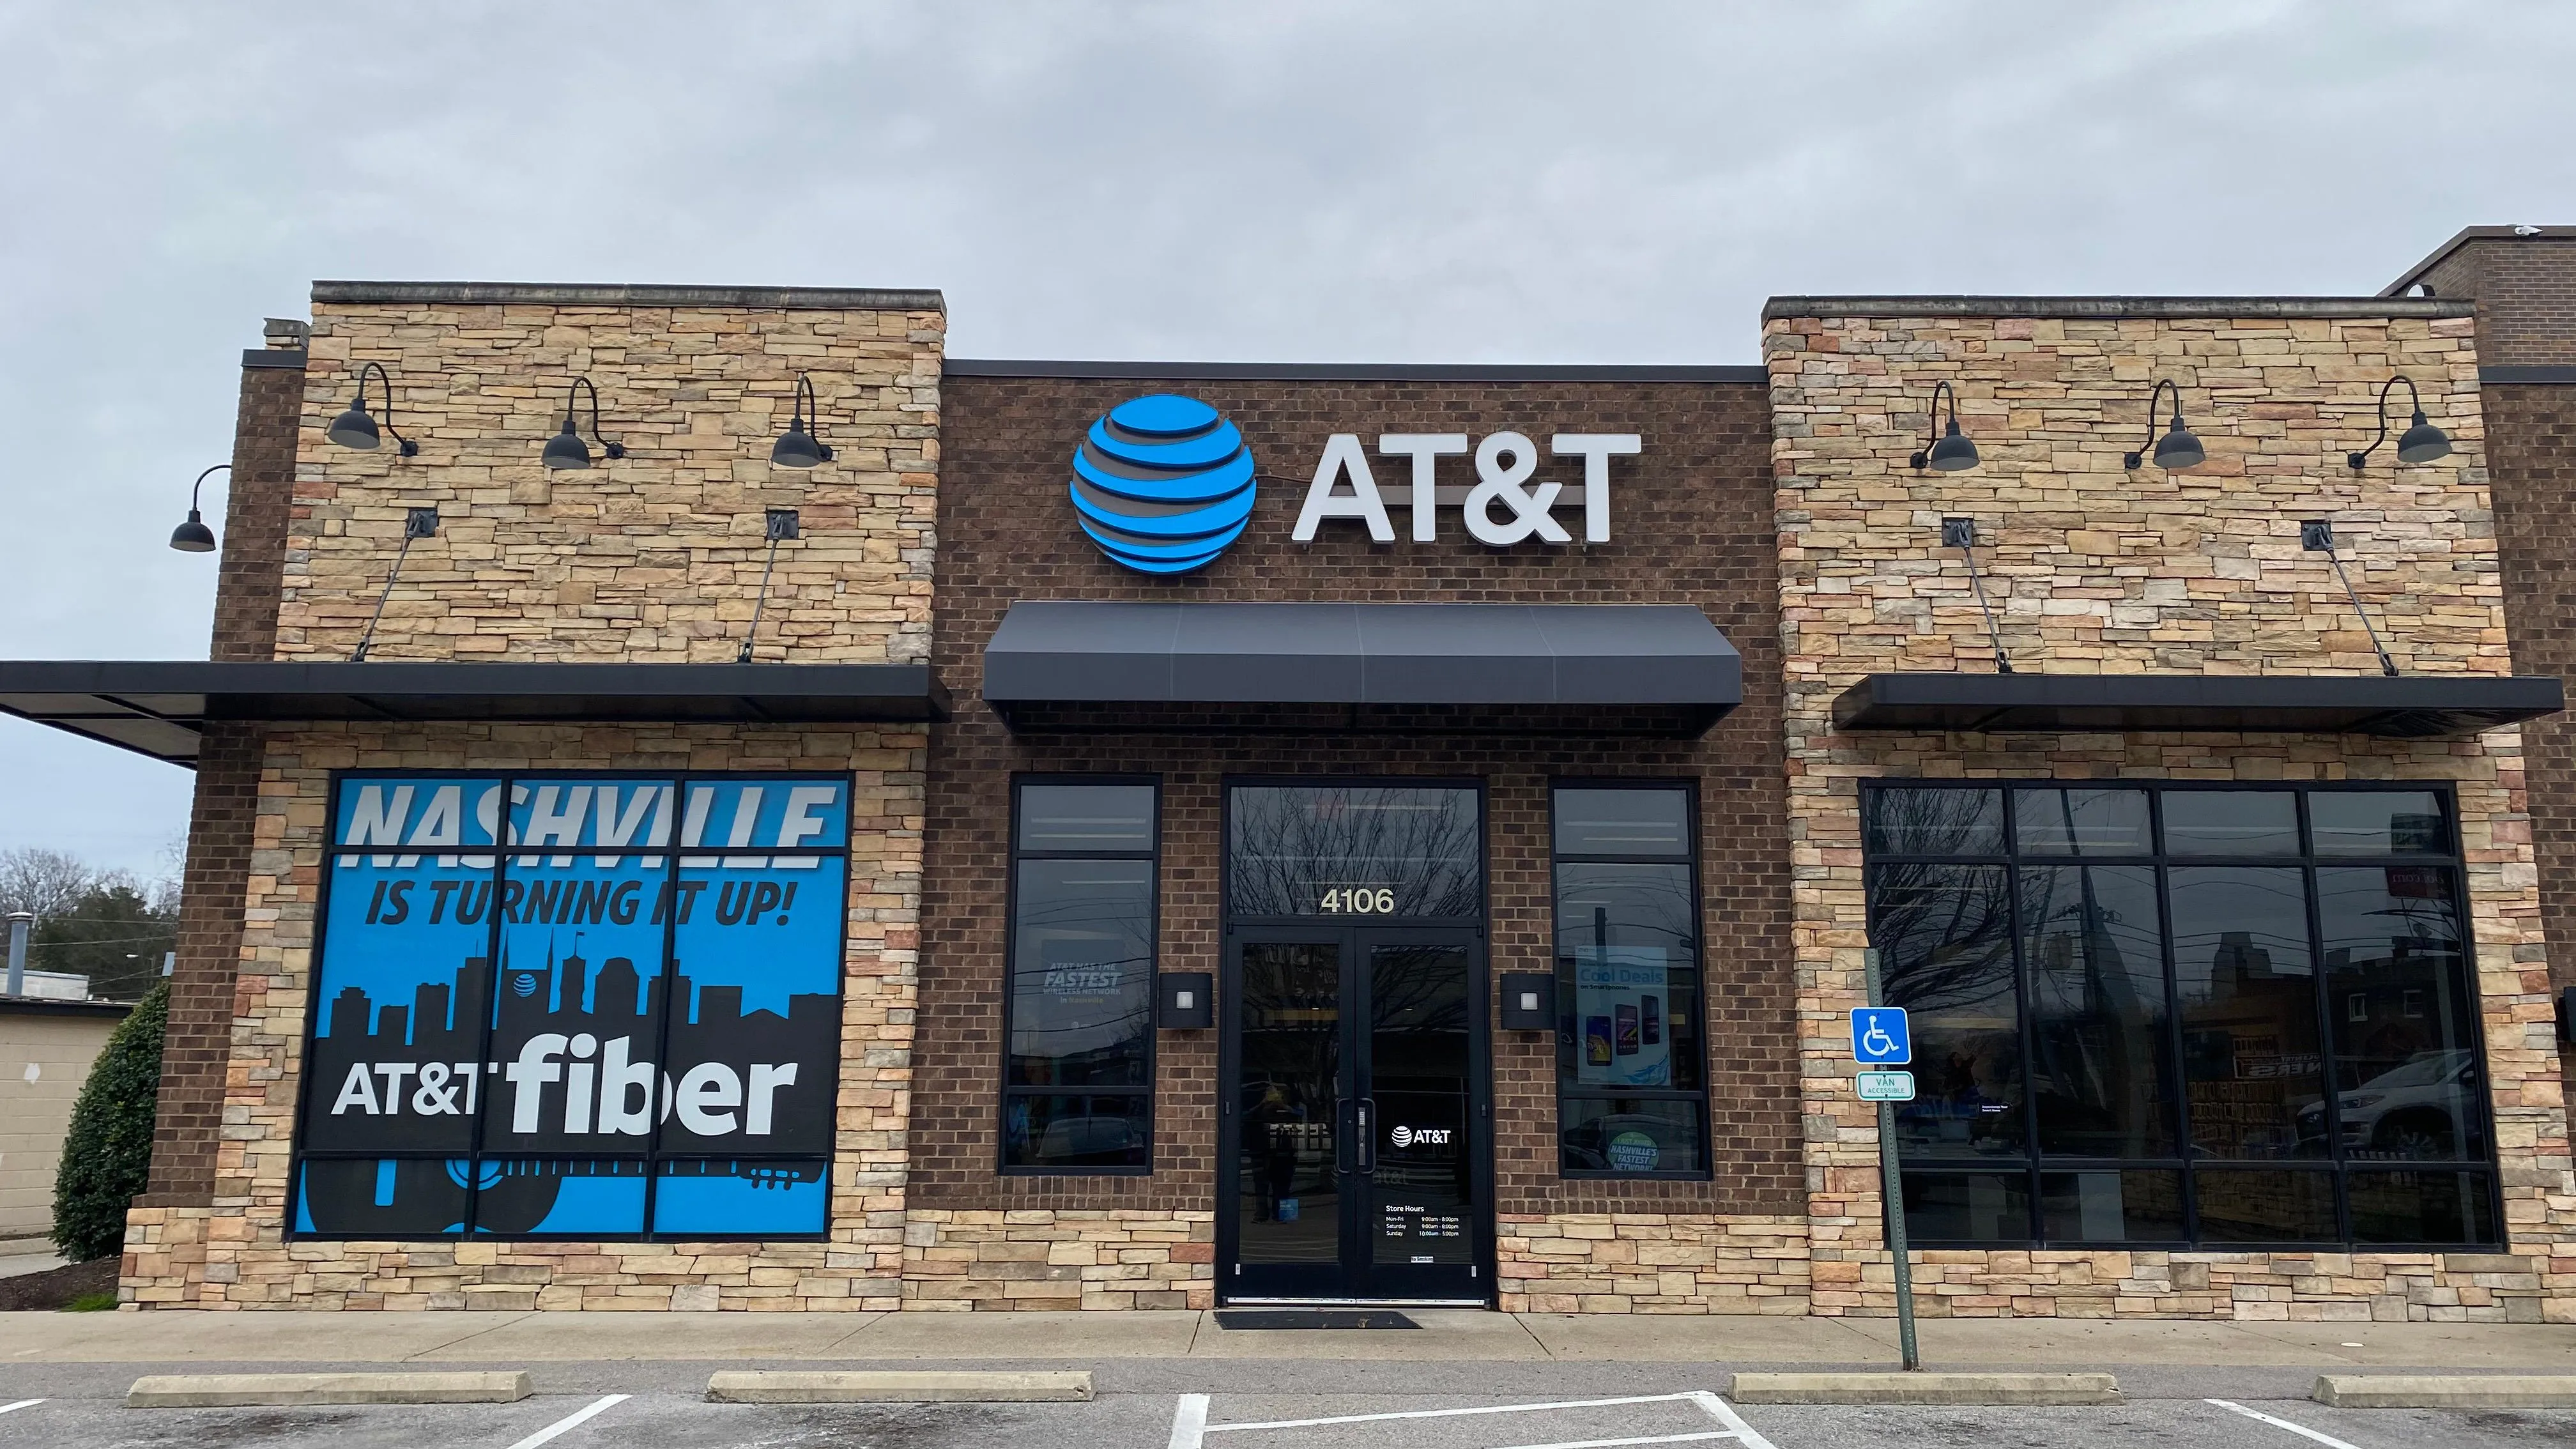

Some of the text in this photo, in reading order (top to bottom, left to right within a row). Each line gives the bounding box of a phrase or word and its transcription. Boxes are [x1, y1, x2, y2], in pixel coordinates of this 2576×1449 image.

[1291, 431, 1642, 547] AT&T
[338, 785, 837, 869] NASHVILLE
[365, 880, 798, 926] IS TURNING IT UP!
[1321, 888, 1394, 914] 4106
[1044, 972, 1123, 988] FASTEST
[1580, 968, 1664, 983] Cool Deals
[330, 1032, 799, 1136] AT&T fiber
[1876, 1078, 1895, 1087] VAN
[1413, 1130, 1451, 1144] AT&T
[1610, 1145, 1658, 1156] NASHVILLE'S
[1617, 1154, 1650, 1165] FASTEST
